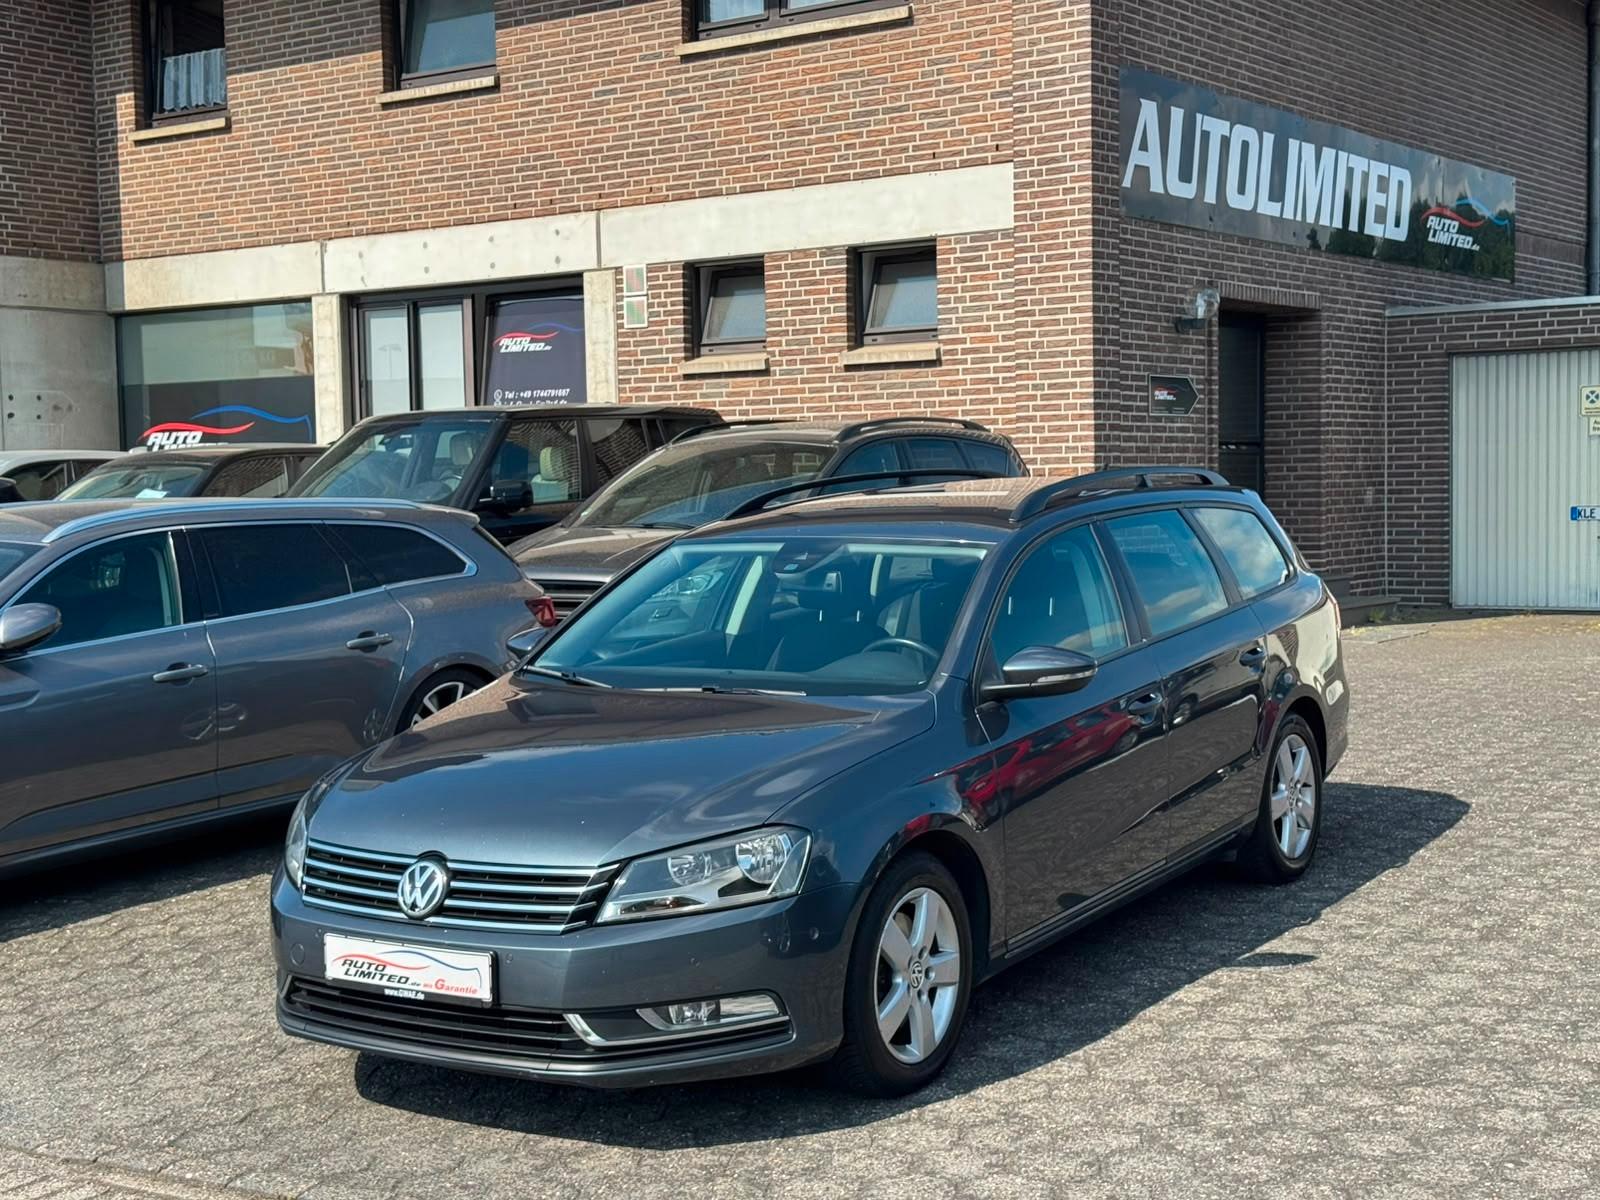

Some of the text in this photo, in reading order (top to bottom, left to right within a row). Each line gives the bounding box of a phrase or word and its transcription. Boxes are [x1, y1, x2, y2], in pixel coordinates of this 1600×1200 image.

[1121, 98, 1412, 242] AUTOLIMITED
[1426, 215, 1460, 234] AUTO
[499, 337, 531, 346] AUTO
[146, 431, 203, 446] AUTO
[1577, 508, 1596, 519] KLE
[401, 862, 444, 913] VW
[341, 958, 387, 973] AUTO
[434, 978, 478, 995] Garantie
